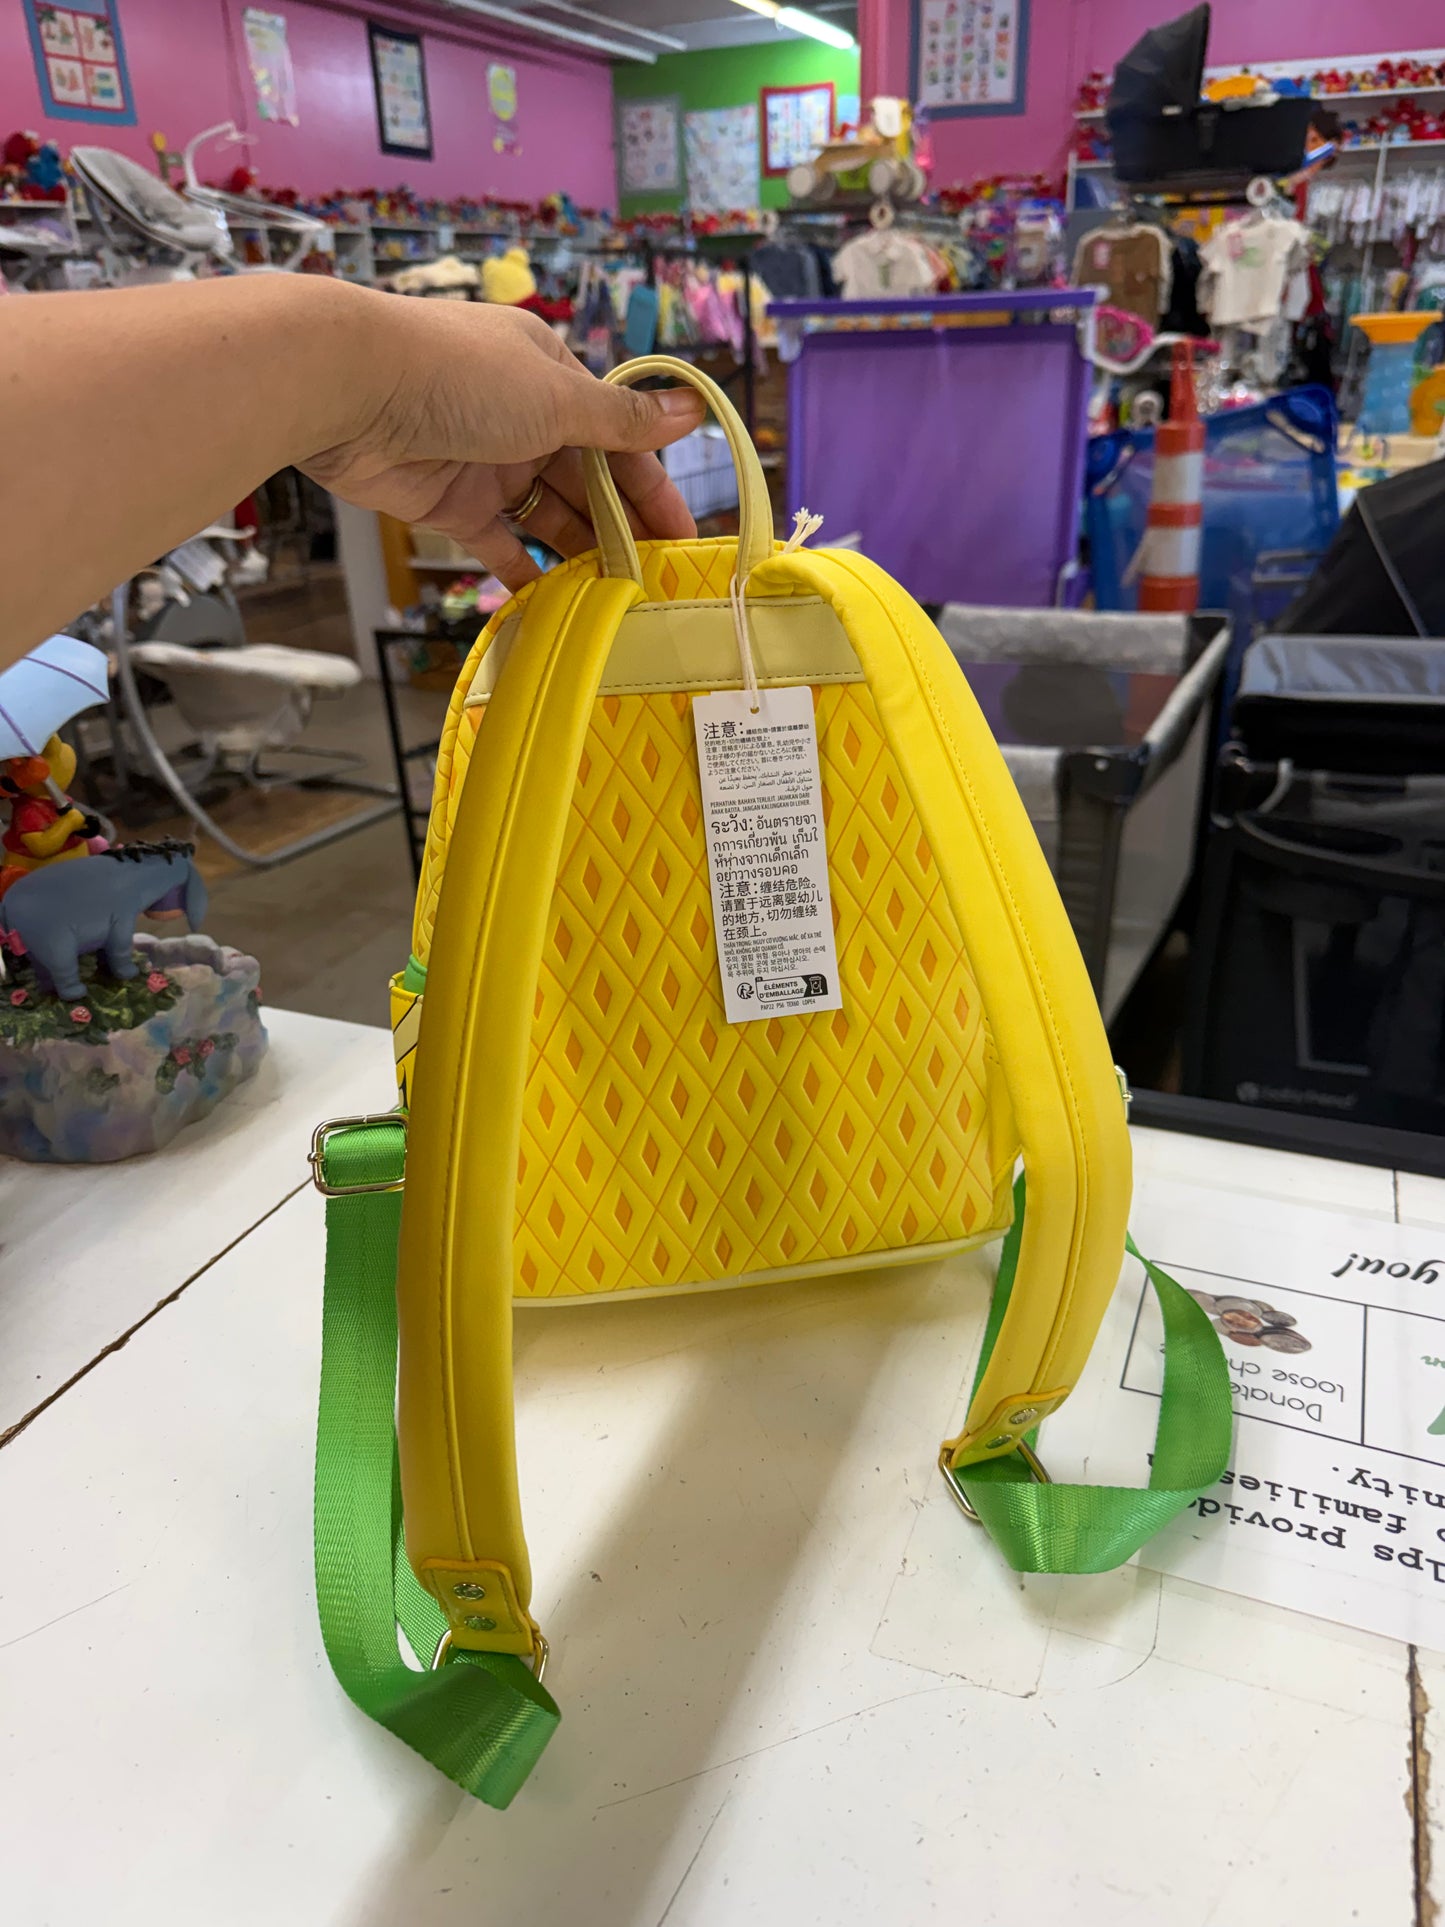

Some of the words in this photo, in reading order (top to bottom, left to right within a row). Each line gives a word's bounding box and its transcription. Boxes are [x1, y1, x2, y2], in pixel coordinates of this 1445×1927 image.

[721, 890, 823, 912] 请置于远离婴幼儿
[760, 988, 804, 998] D'EMBALLAGE
[764, 982, 798, 990] ÉLÉMENTS
[1272, 1369, 1344, 1402] loose
[1187, 1497, 1346, 1549] provid
